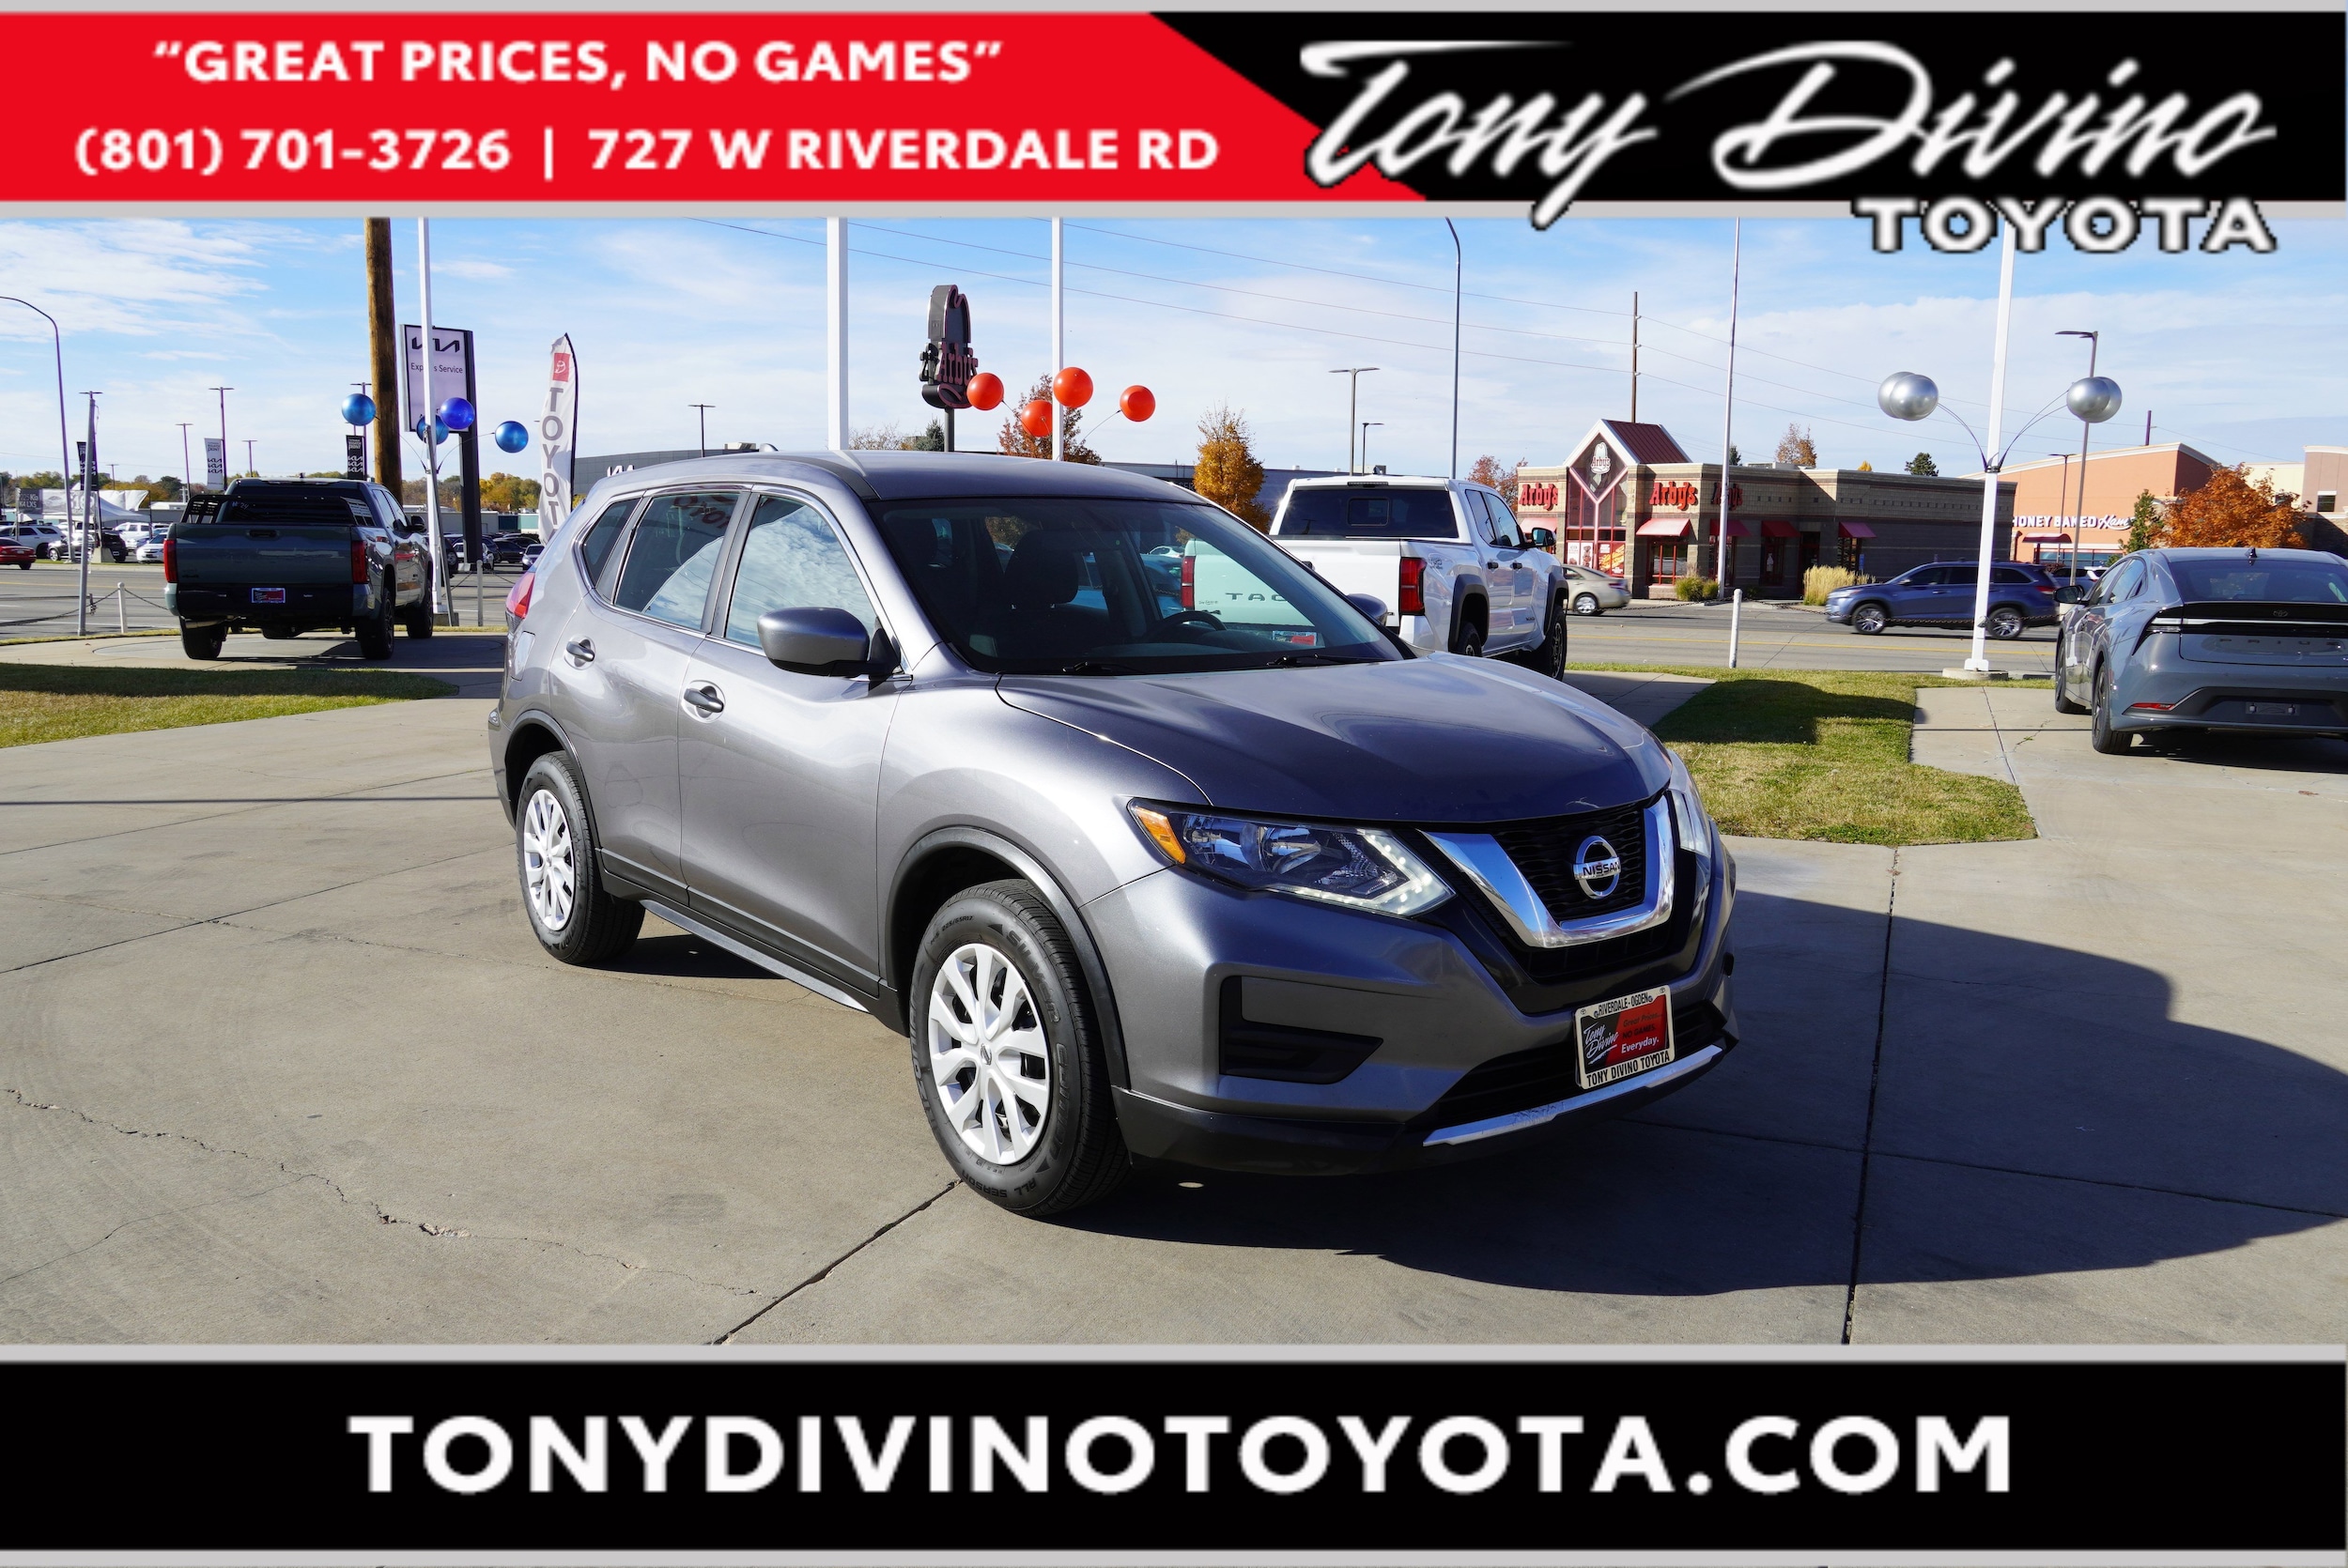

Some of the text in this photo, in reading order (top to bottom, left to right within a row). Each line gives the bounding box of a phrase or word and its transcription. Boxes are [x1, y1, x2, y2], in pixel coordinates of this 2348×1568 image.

[410, 362, 463, 374] Exps Service
[542, 387, 564, 537] TOYOT
[1519, 483, 1559, 510] Arby's
[1649, 481, 1698, 510] Arby's
[1710, 482, 1743, 511] Ay's
[2013, 515, 2131, 530] HONEY BAKED Ham
[1225, 592, 1289, 602] TAC
[1583, 861, 1620, 876] NISSAN
[1598, 998, 1629, 1017] RIVERDALE
[1630, 992, 1648, 1007] OGDEN
[1583, 1022, 1606, 1045] Tony
[1585, 1032, 1620, 1059] Divino
[1621, 1036, 1660, 1054] Everyday.
[1622, 1030, 1633, 1039] NO
[1586, 1050, 1671, 1087] TONY DIVINO TOYOTA
